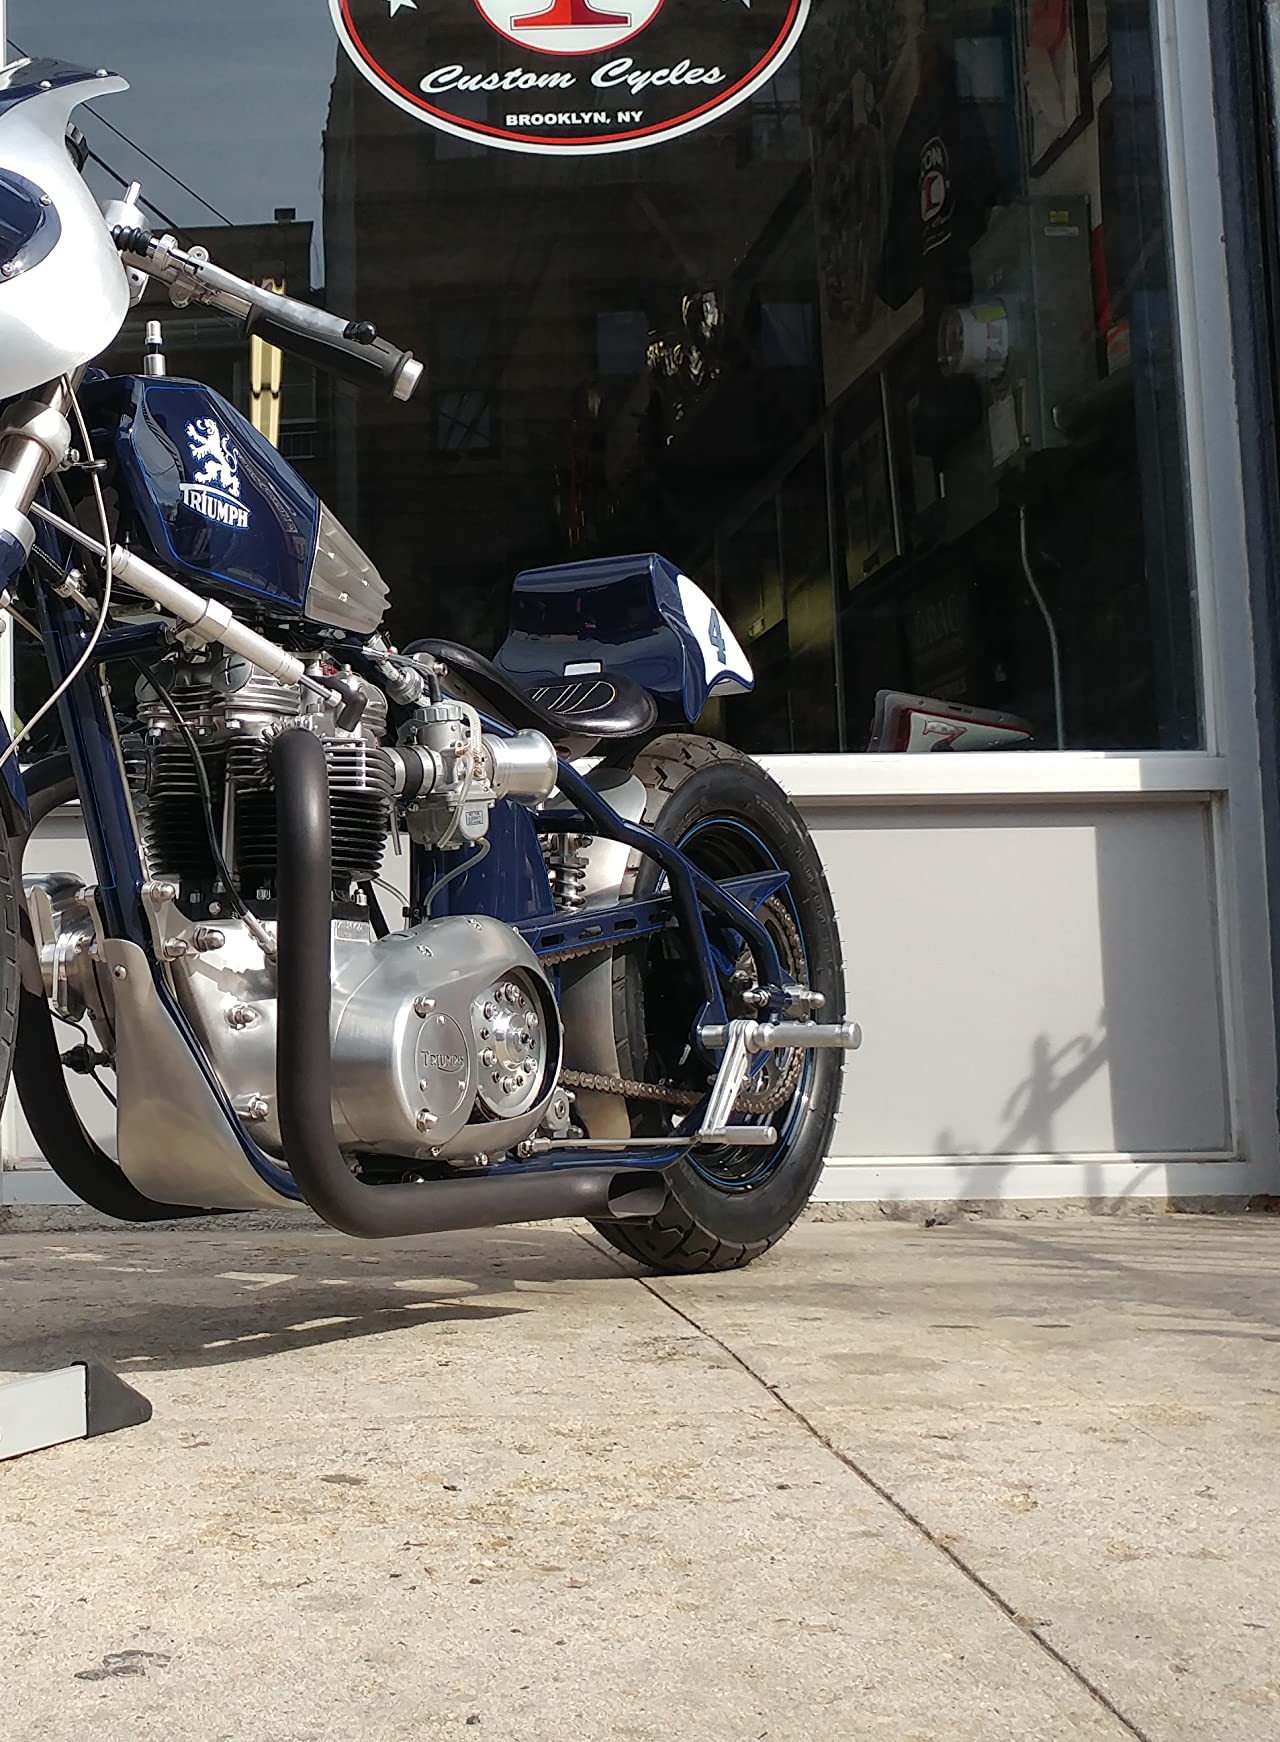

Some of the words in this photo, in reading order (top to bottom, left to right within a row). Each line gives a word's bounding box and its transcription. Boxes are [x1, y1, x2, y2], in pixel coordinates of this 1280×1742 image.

[419, 64, 576, 94] Custom
[590, 57, 726, 95] Cycles
[505, 111, 611, 126] BROOKLYN,
[617, 110, 643, 123] NY
[179, 483, 251, 528] TRIUMPH
[708, 607, 727, 666] 4
